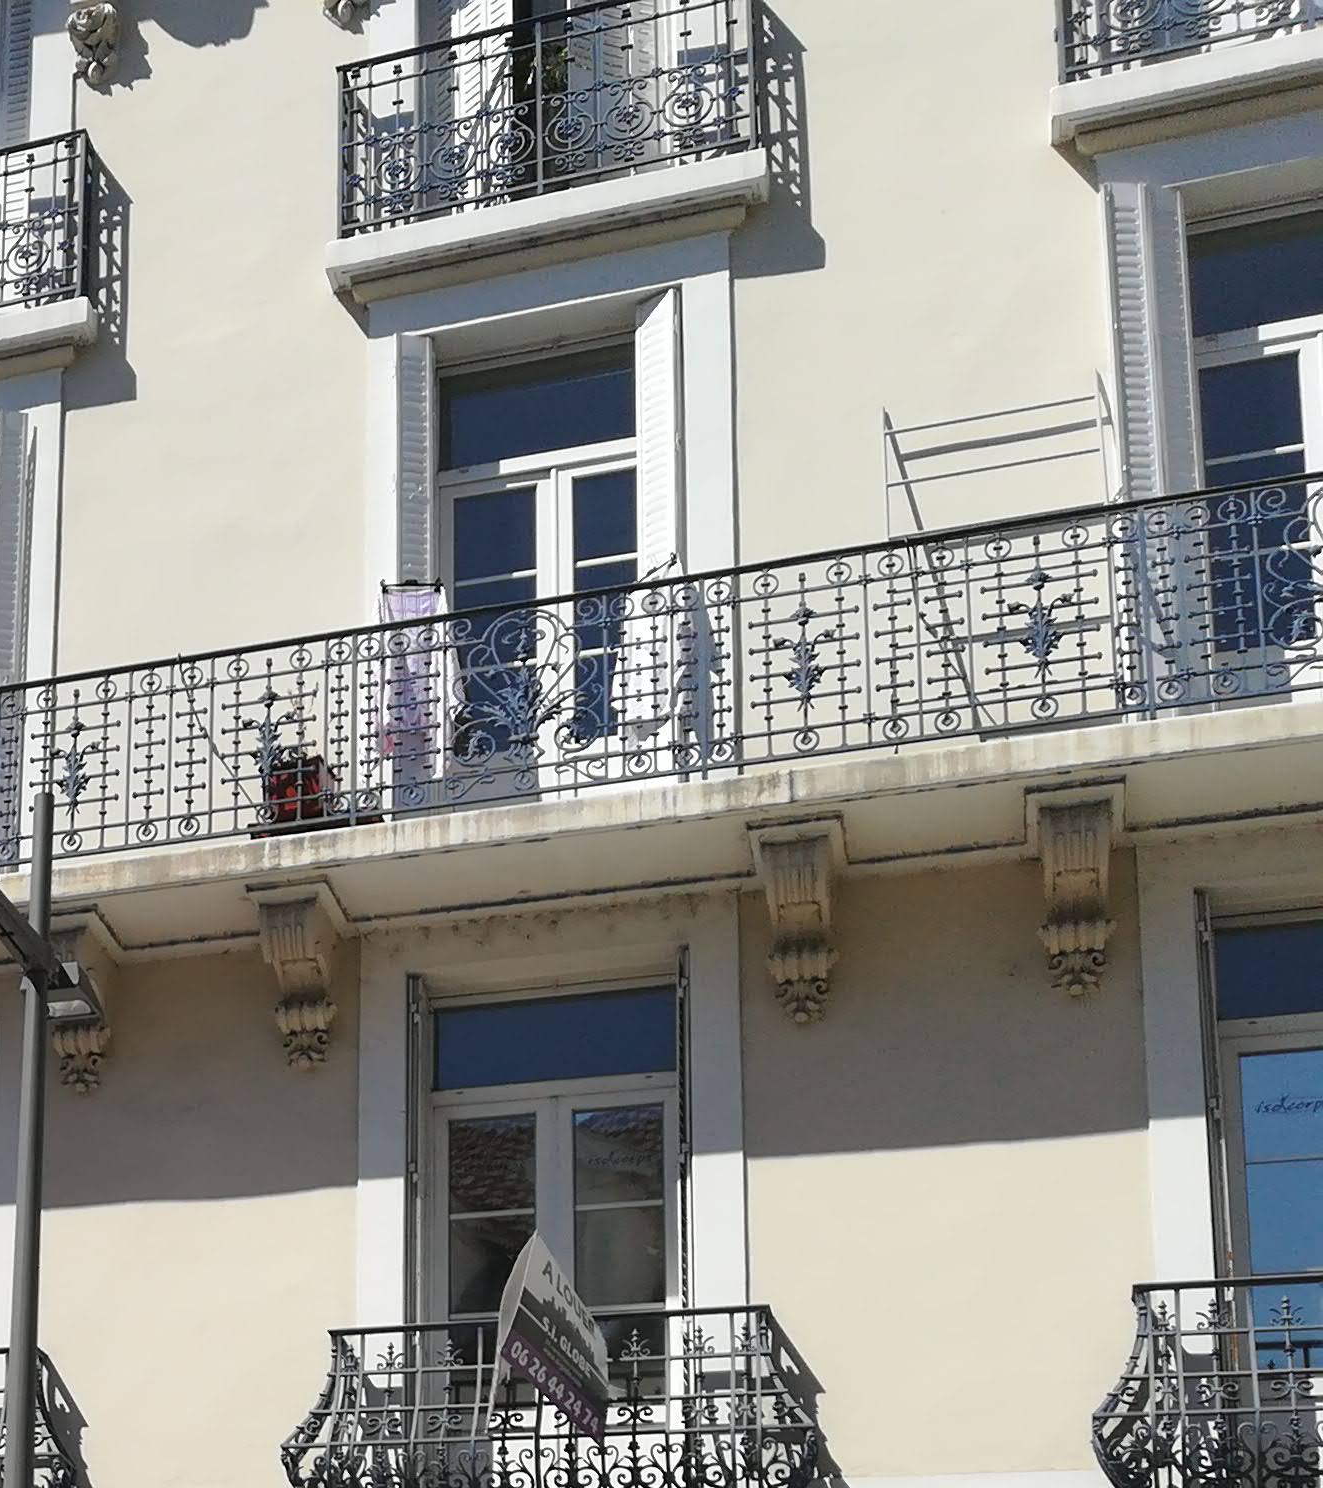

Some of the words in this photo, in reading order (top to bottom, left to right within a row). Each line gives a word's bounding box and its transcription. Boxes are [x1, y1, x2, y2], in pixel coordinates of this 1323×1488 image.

[542, 1259, 553, 1284] A
[557, 1273, 595, 1335] LOUER
[511, 1340, 528, 1367] 06
[528, 1357, 547, 1384] 26
[547, 1375, 564, 1401] 44
[564, 1391, 583, 1417] 24
[582, 1407, 599, 1433] 74
[559, 1335, 592, 1380] GLOBE
